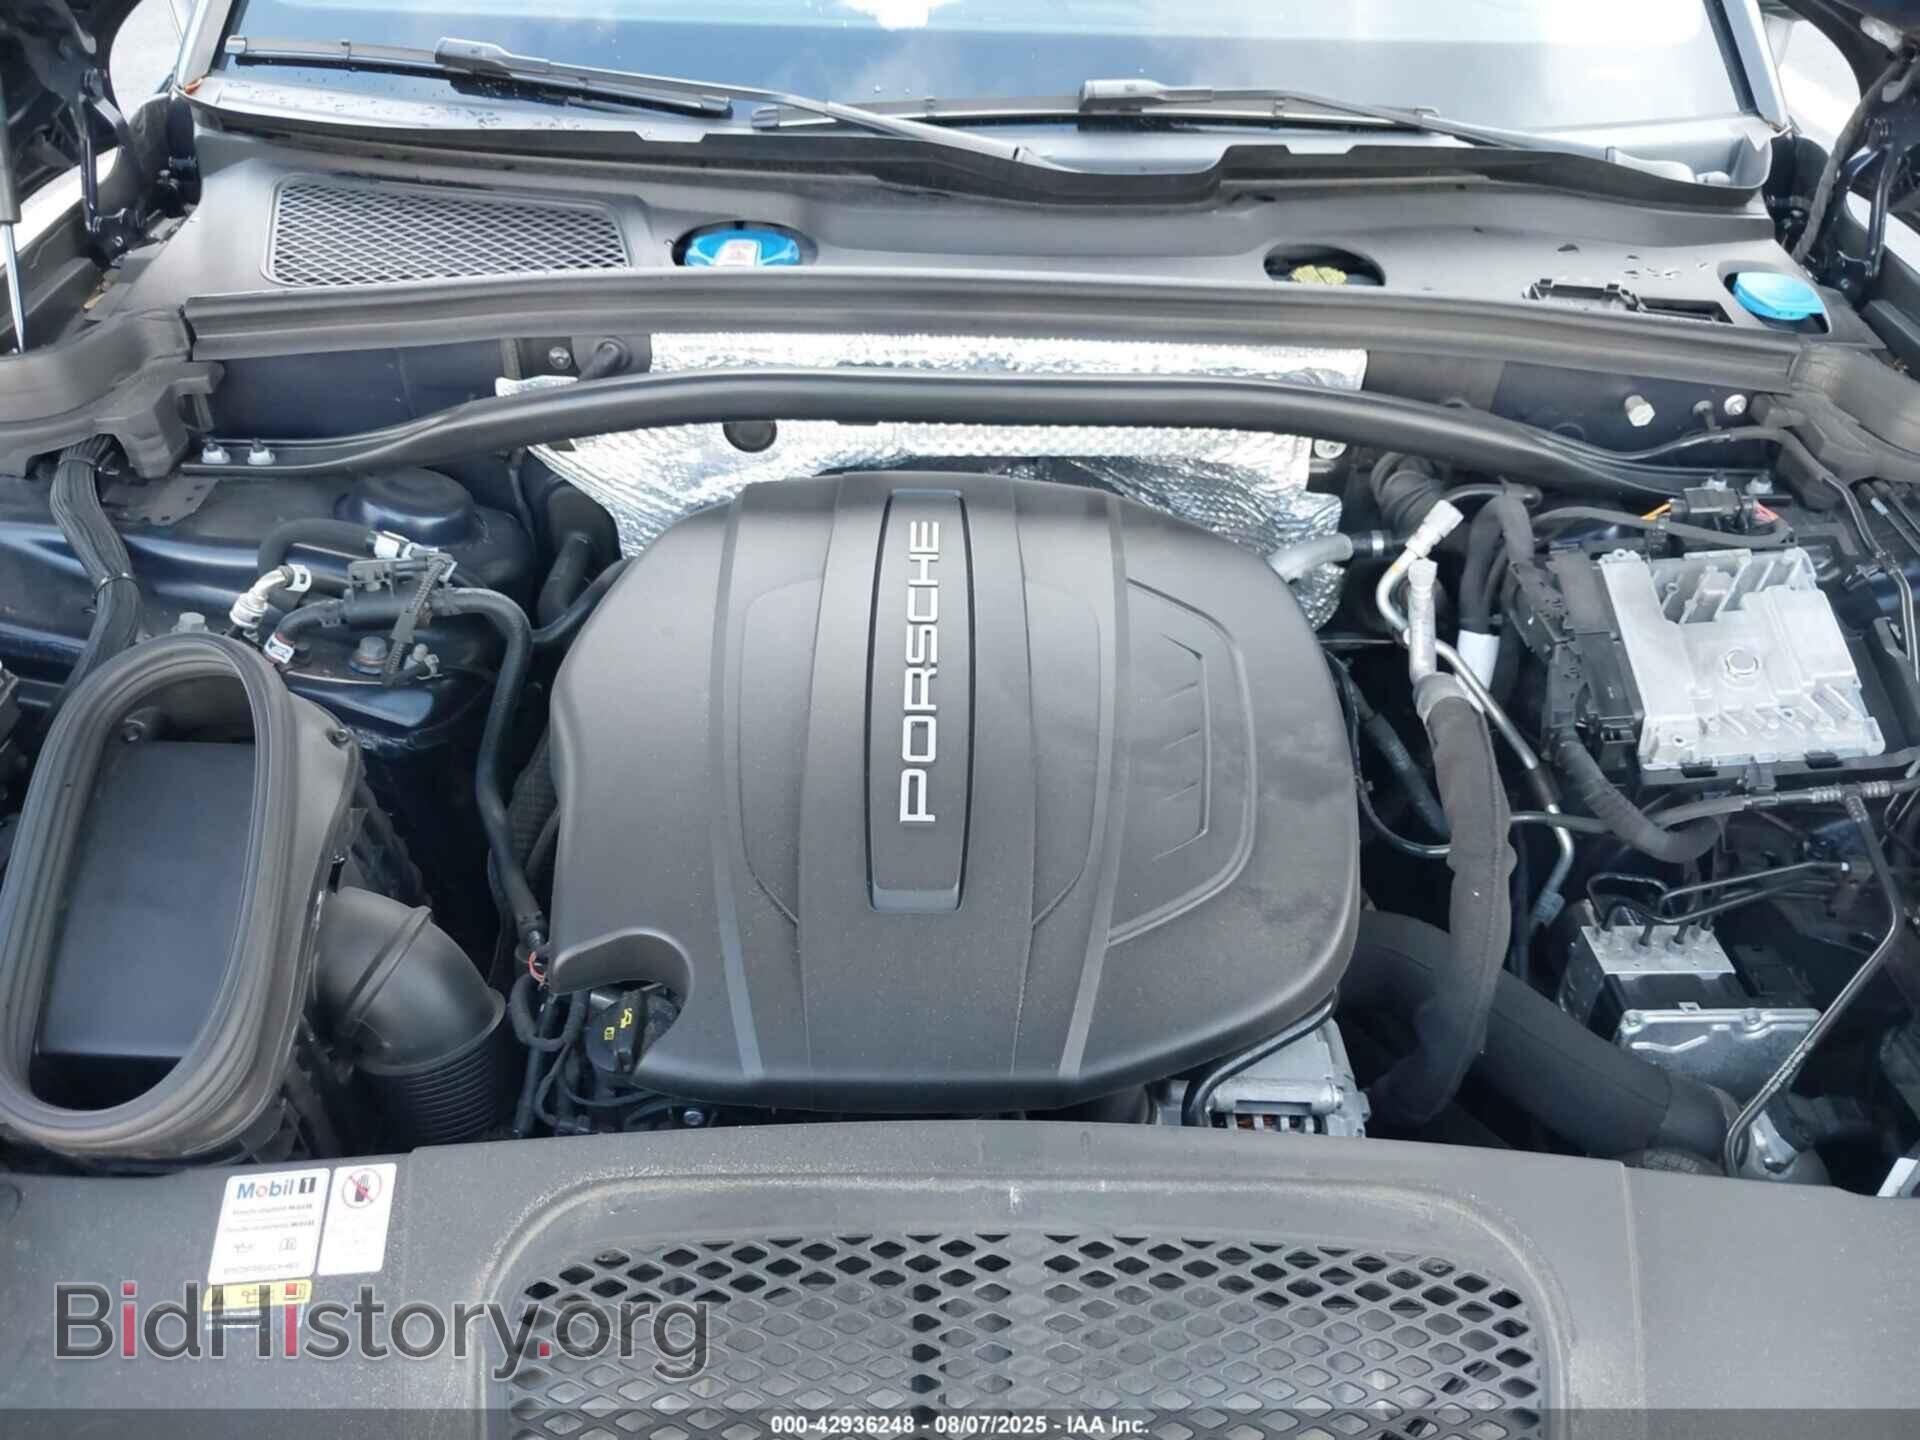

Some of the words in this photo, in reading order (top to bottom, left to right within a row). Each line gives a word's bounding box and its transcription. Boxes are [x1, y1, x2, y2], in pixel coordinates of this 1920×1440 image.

[899, 520, 940, 823] PORSCHE
[236, 1178, 295, 1200] Mobil
[298, 1177, 317, 1194] 1
